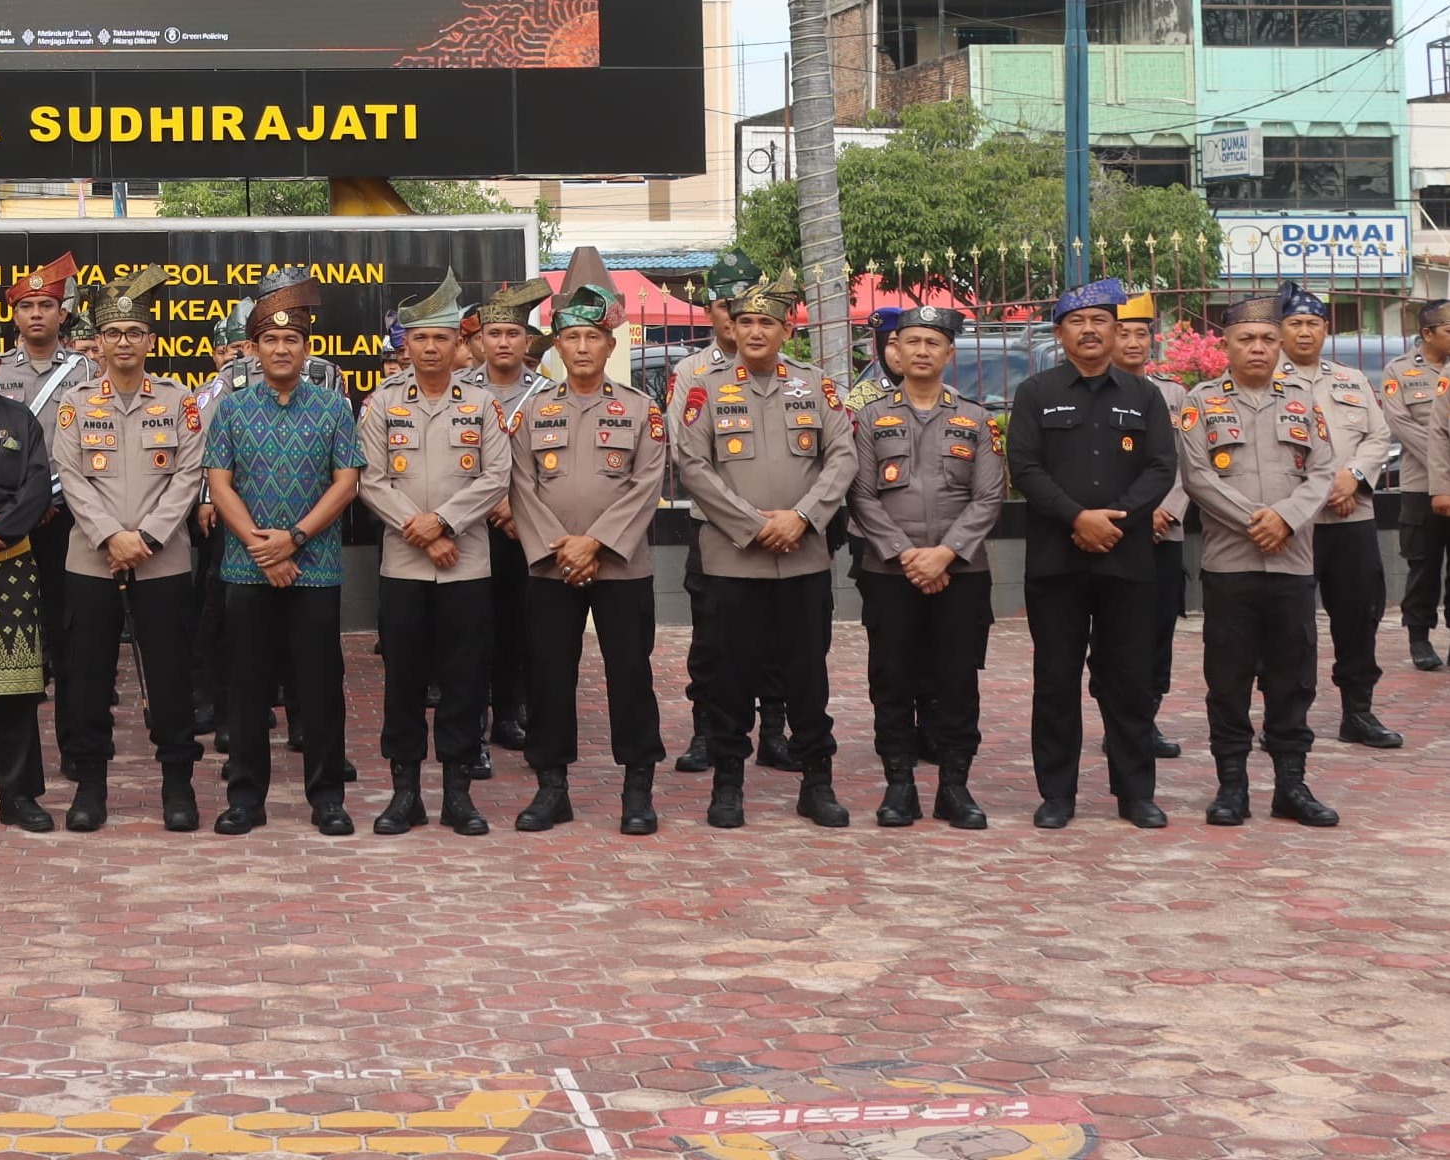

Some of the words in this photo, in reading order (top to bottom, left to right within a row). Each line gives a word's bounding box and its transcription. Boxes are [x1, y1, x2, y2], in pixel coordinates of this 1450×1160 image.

[29, 103, 418, 144] SUDHIRAJATI
[1221, 136, 1248, 151] DUMAI
[1221, 151, 1248, 163] OPTICAL
[1282, 224, 1394, 242] DUMAI
[1282, 244, 1394, 257] OPTICAL
[11, 264, 108, 286] HYA
[1332, 382, 1360, 390] POLRI
[716, 406, 748, 415] RONNI
[785, 401, 816, 410] POLRI
[83, 420, 114, 429] ANGGA
[142, 418, 174, 428] POLRI
[452, 417, 483, 426] POLRI
[534, 419, 567, 429] IMRAN
[599, 418, 632, 428] POLRI
[945, 429, 978, 442] POLRI
[702, 1101, 1032, 1125] PRESISI
